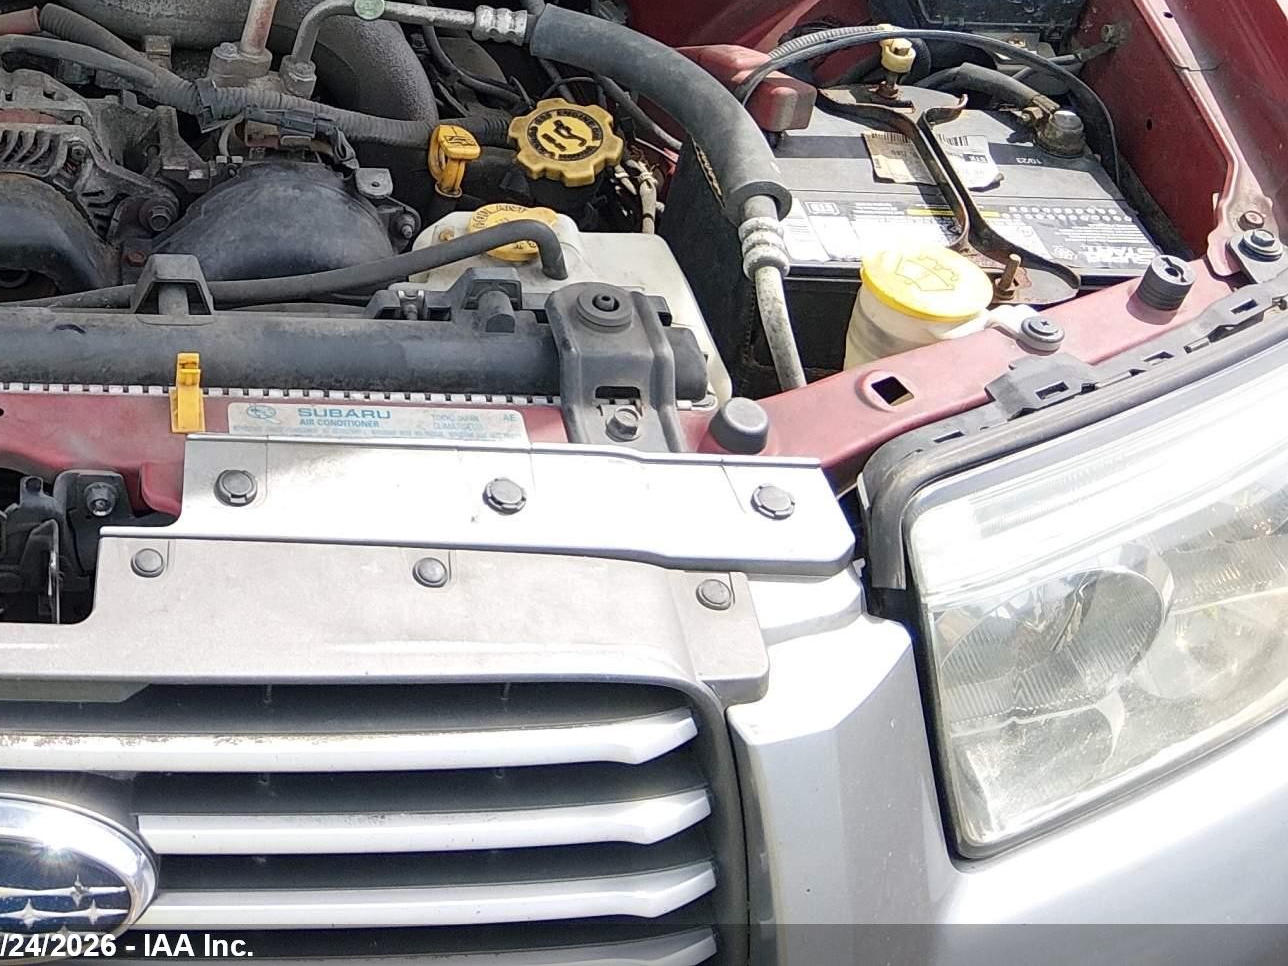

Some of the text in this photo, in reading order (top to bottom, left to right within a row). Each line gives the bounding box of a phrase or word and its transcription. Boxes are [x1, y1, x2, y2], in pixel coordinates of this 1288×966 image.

[297, 407, 391, 419] SUBARU
[299, 418, 380, 428] AIR CONDITIONER
